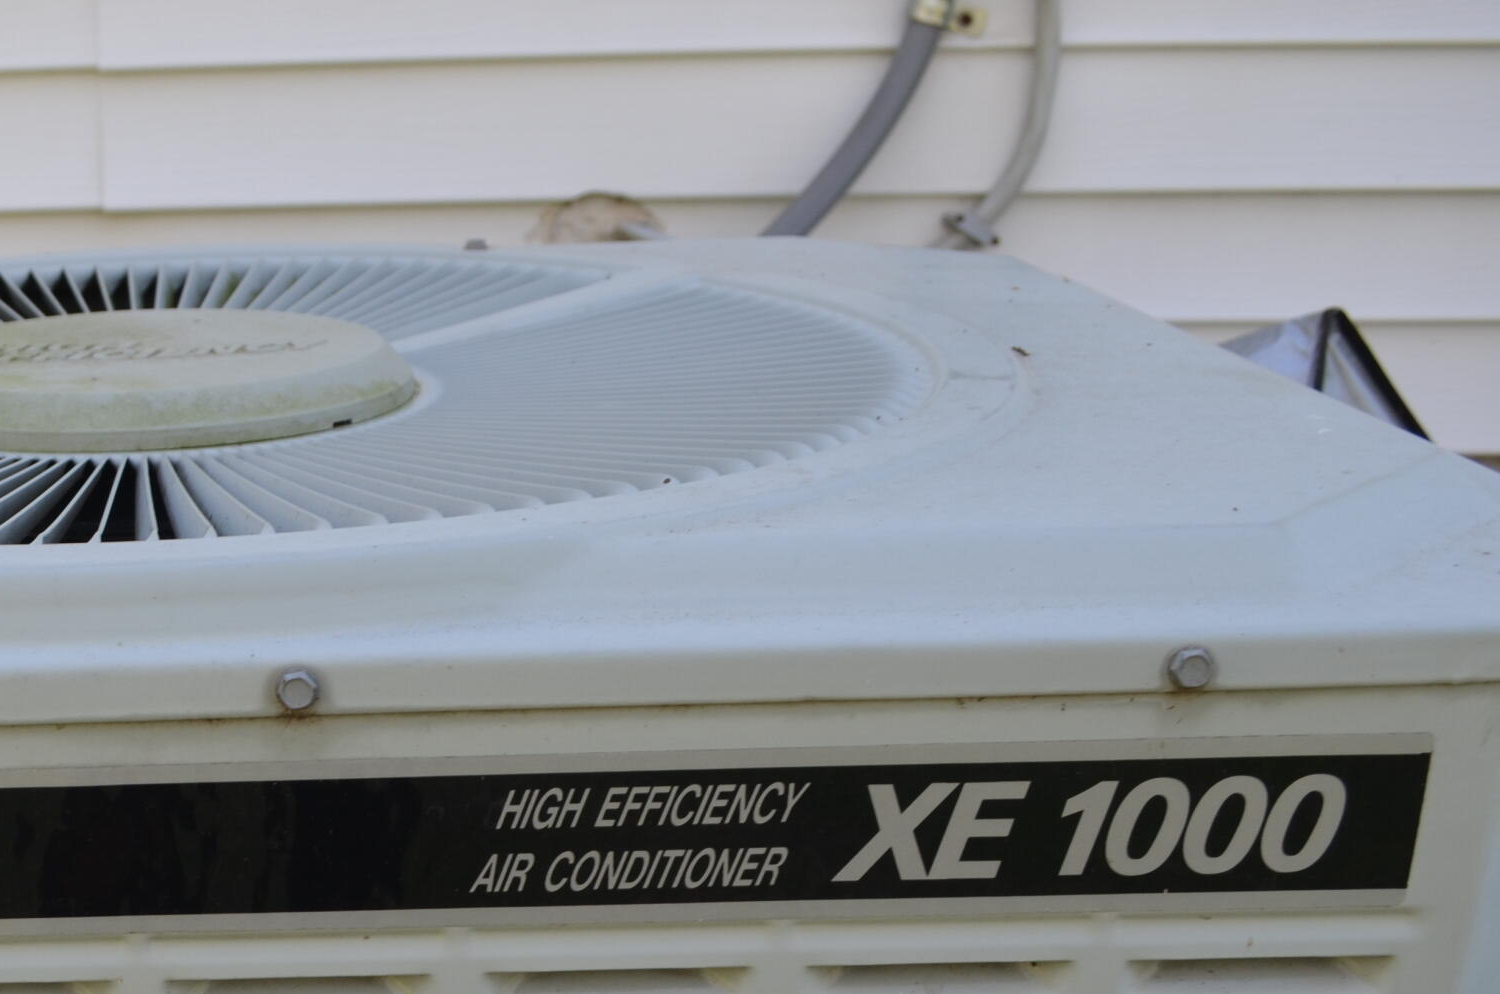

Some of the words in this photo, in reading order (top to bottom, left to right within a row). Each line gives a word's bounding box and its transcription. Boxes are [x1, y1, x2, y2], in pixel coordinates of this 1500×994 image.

[496, 787, 591, 830] HIGH
[594, 781, 812, 828] EFFICIENCY
[831, 780, 1032, 882] XE
[1058, 773, 1347, 877] 1000
[469, 853, 535, 893] AIR
[545, 847, 788, 892] CONDITIONER
